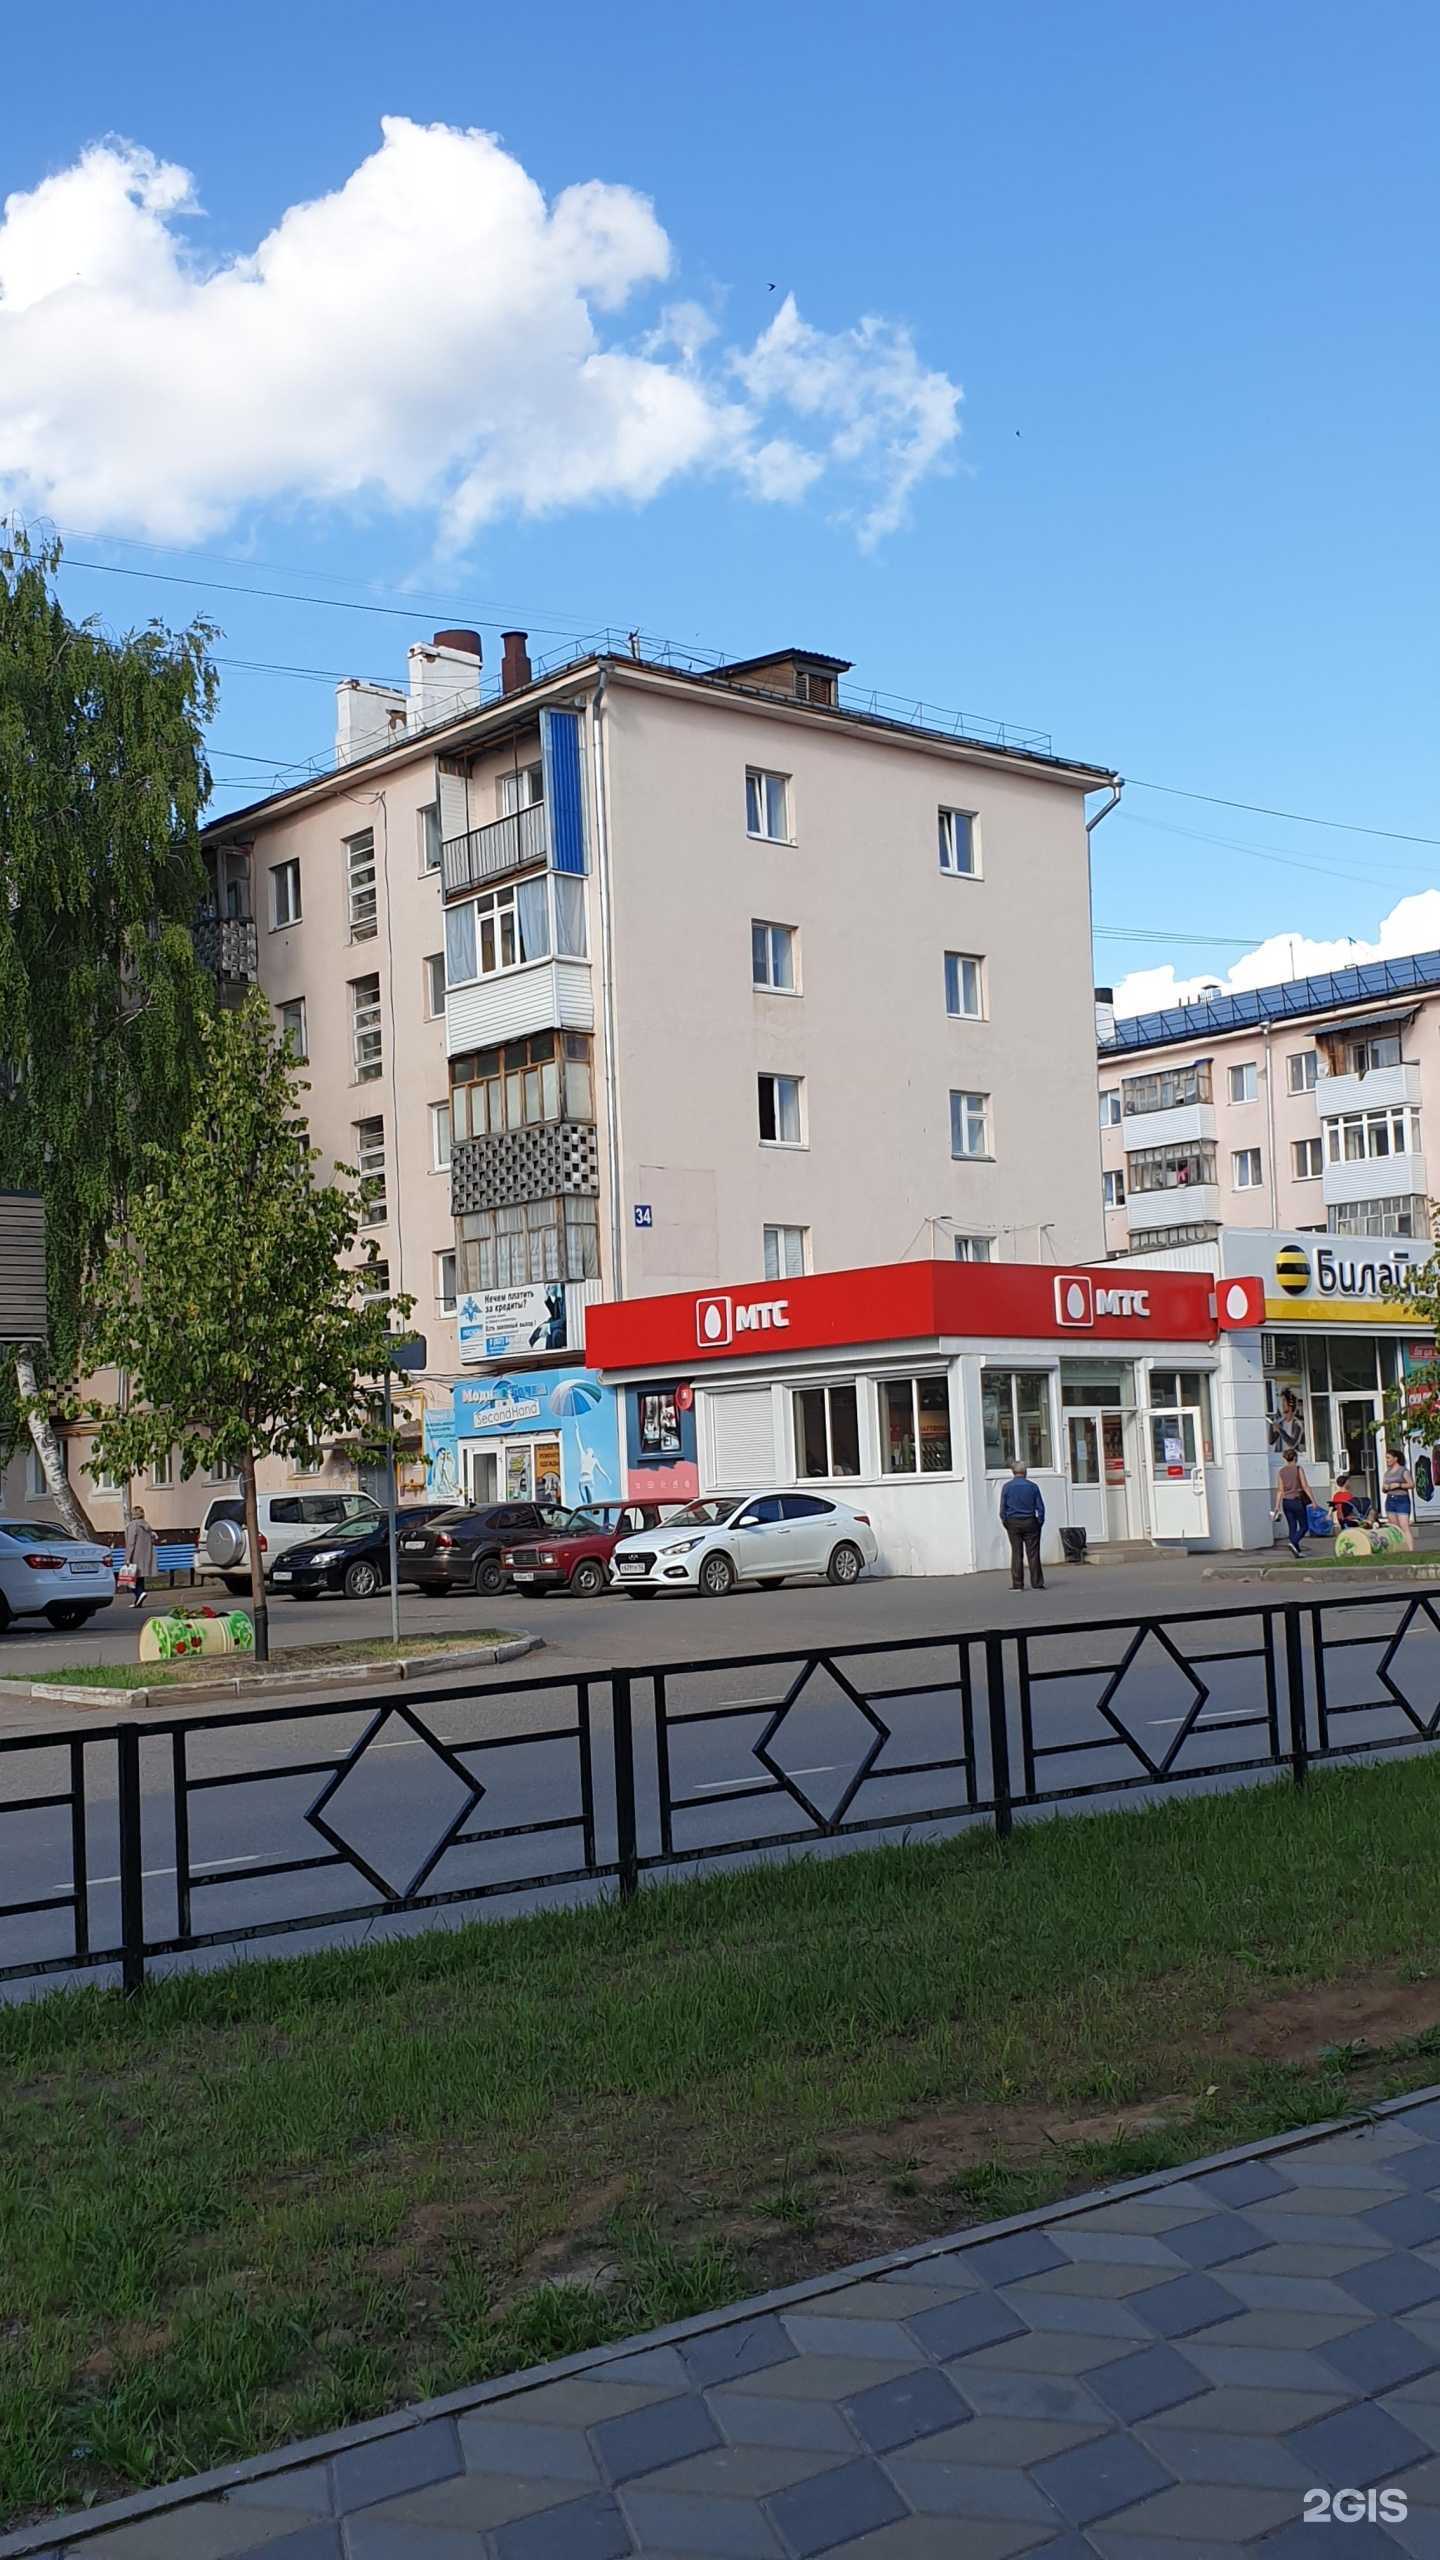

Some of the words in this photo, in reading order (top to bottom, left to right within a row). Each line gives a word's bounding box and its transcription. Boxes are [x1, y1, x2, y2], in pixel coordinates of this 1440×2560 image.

[635, 1207, 651, 1224] 34
[484, 1292, 506, 1304] Нечем
[508, 1290, 534, 1302] платить
[1096, 1289, 1150, 1316] МТС
[485, 1305, 494, 1313] за
[495, 1299, 527, 1313] кредиты?
[736, 1300, 790, 1332] МТС
